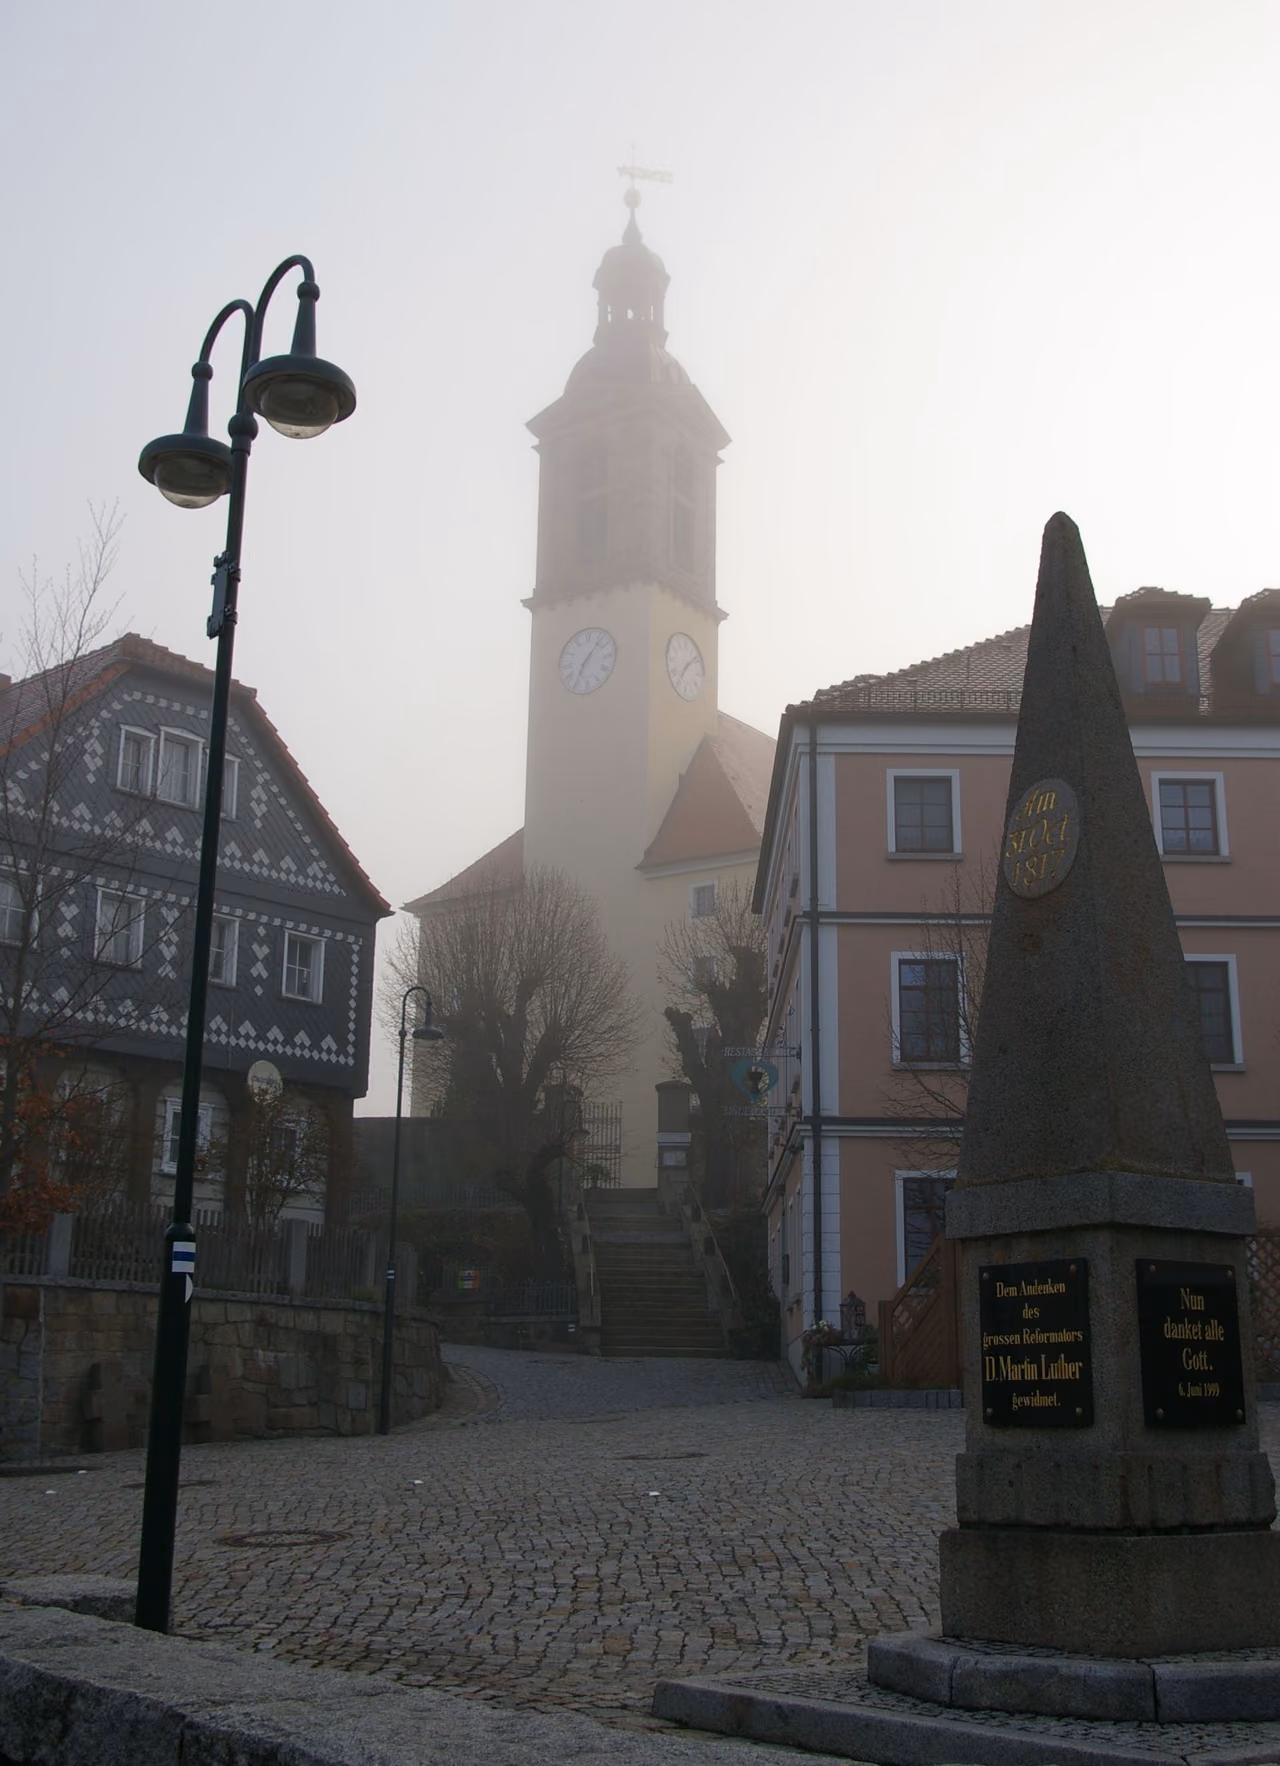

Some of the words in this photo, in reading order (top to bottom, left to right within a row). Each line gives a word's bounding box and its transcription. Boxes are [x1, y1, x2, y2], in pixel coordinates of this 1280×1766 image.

[1013, 849, 1065, 886] 1817
[996, 1282, 1018, 1298] Dem
[1019, 1278, 1066, 1297] Andenken
[1180, 1287, 1205, 1310] Nun
[1022, 1303, 1041, 1319] des
[982, 1332, 1021, 1350] grossen
[1022, 1328, 1084, 1345] Reformators
[1163, 1316, 1202, 1340] danket
[1204, 1319, 1225, 1341] alle
[1040, 1353, 1083, 1380] Luther
[1187, 1382, 1203, 1398] Juni
[1204, 1382, 1220, 1398] 1999
